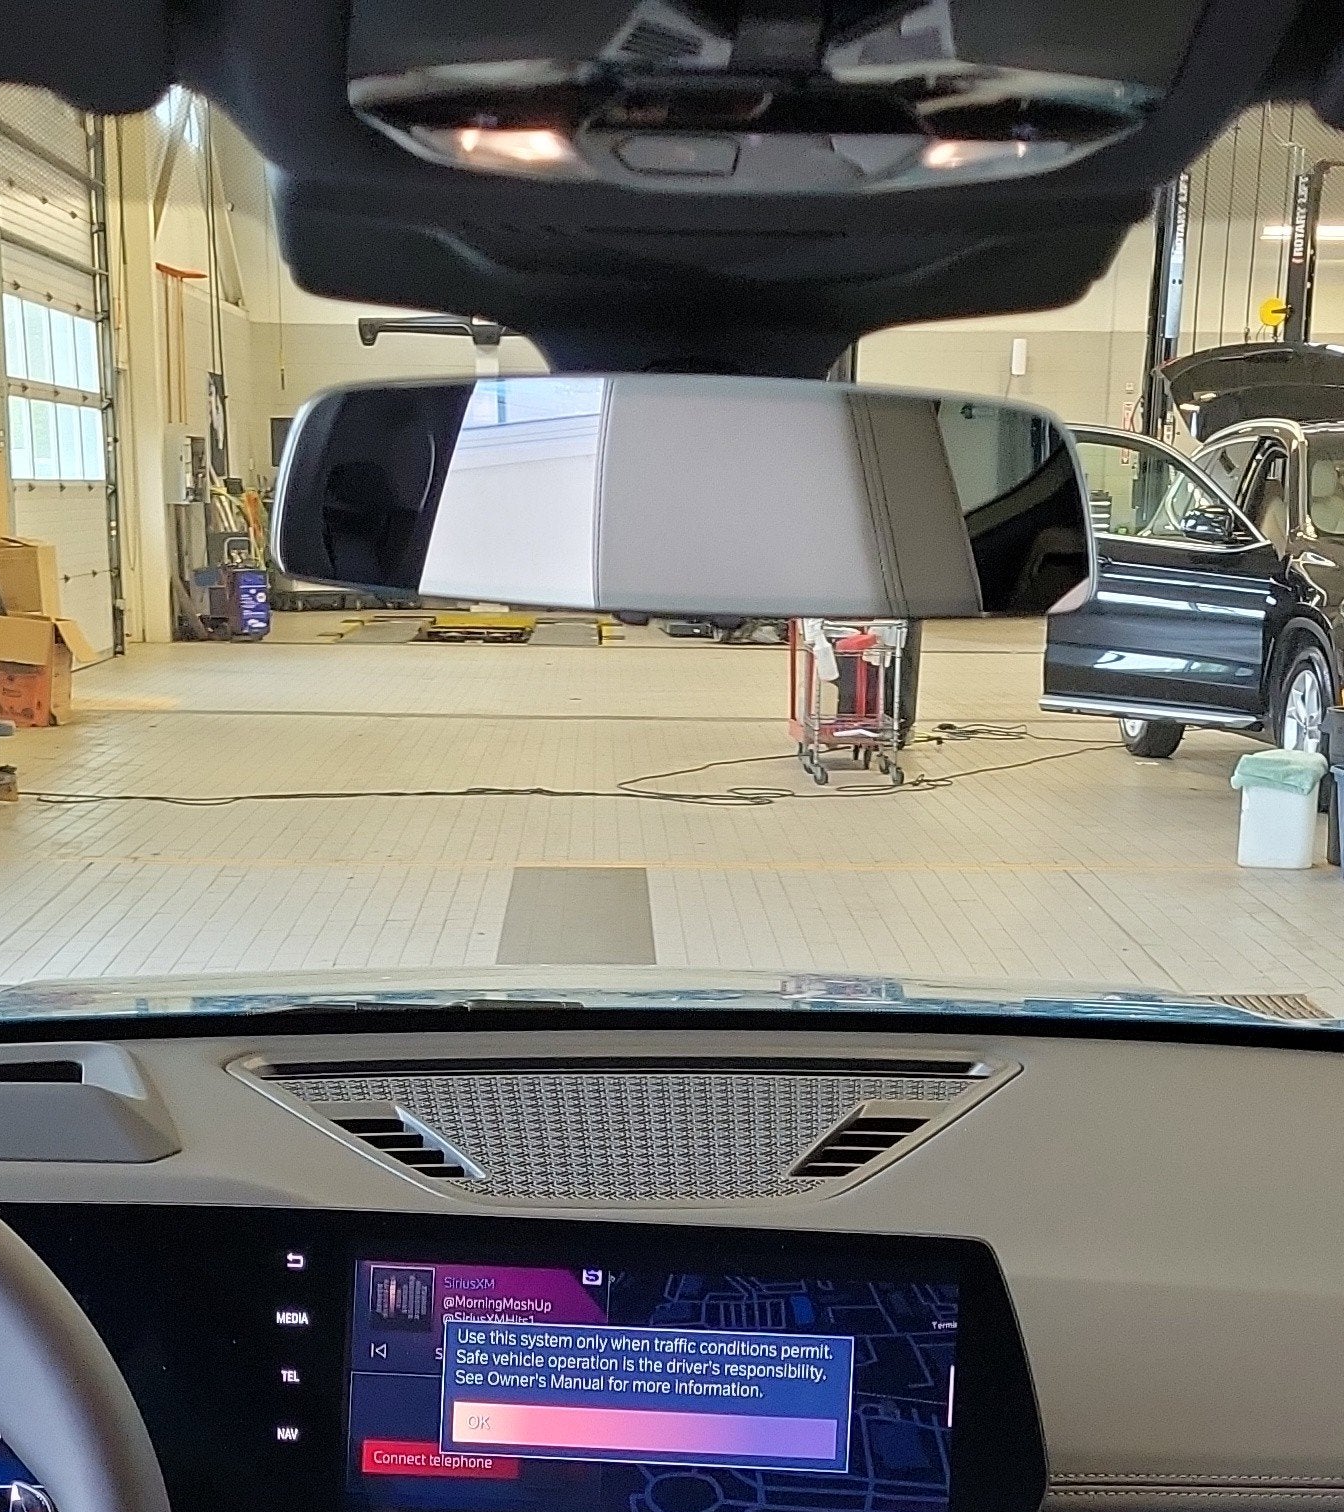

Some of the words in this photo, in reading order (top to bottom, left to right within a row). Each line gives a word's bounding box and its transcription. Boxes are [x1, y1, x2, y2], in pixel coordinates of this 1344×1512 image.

[443, 1276, 495, 1290] SiriusXM
[443, 1295, 552, 1313] @MorningMashUp
[276, 1311, 309, 1325] MEDIA
[457, 1328, 486, 1344] Use
[489, 1330, 517, 1346] this
[520, 1333, 573, 1350] system
[576, 1334, 608, 1353] only
[610, 1335, 650, 1352] when
[654, 1337, 697, 1354] traffic
[699, 1340, 777, 1357] conditions
[780, 1344, 833, 1360] permit.
[456, 1349, 489, 1365] Safe
[492, 1351, 545, 1368] vehicle
[548, 1354, 618, 1372] operation
[623, 1356, 635, 1372] is
[638, 1357, 663, 1373] the
[666, 1359, 721, 1376] driver's
[724, 1363, 827, 1383] responsibility.
[280, 1369, 301, 1383] TEL
[455, 1370, 484, 1385] See
[487, 1371, 547, 1388] Owner's
[550, 1374, 605, 1391] Manual
[608, 1376, 629, 1392] for
[632, 1380, 671, 1394] more
[675, 1379, 764, 1398] information.
[466, 1415, 492, 1431] OK
[276, 1427, 299, 1440] NAV
[373, 1450, 427, 1466] Connect
[429, 1454, 493, 1470] telephone
